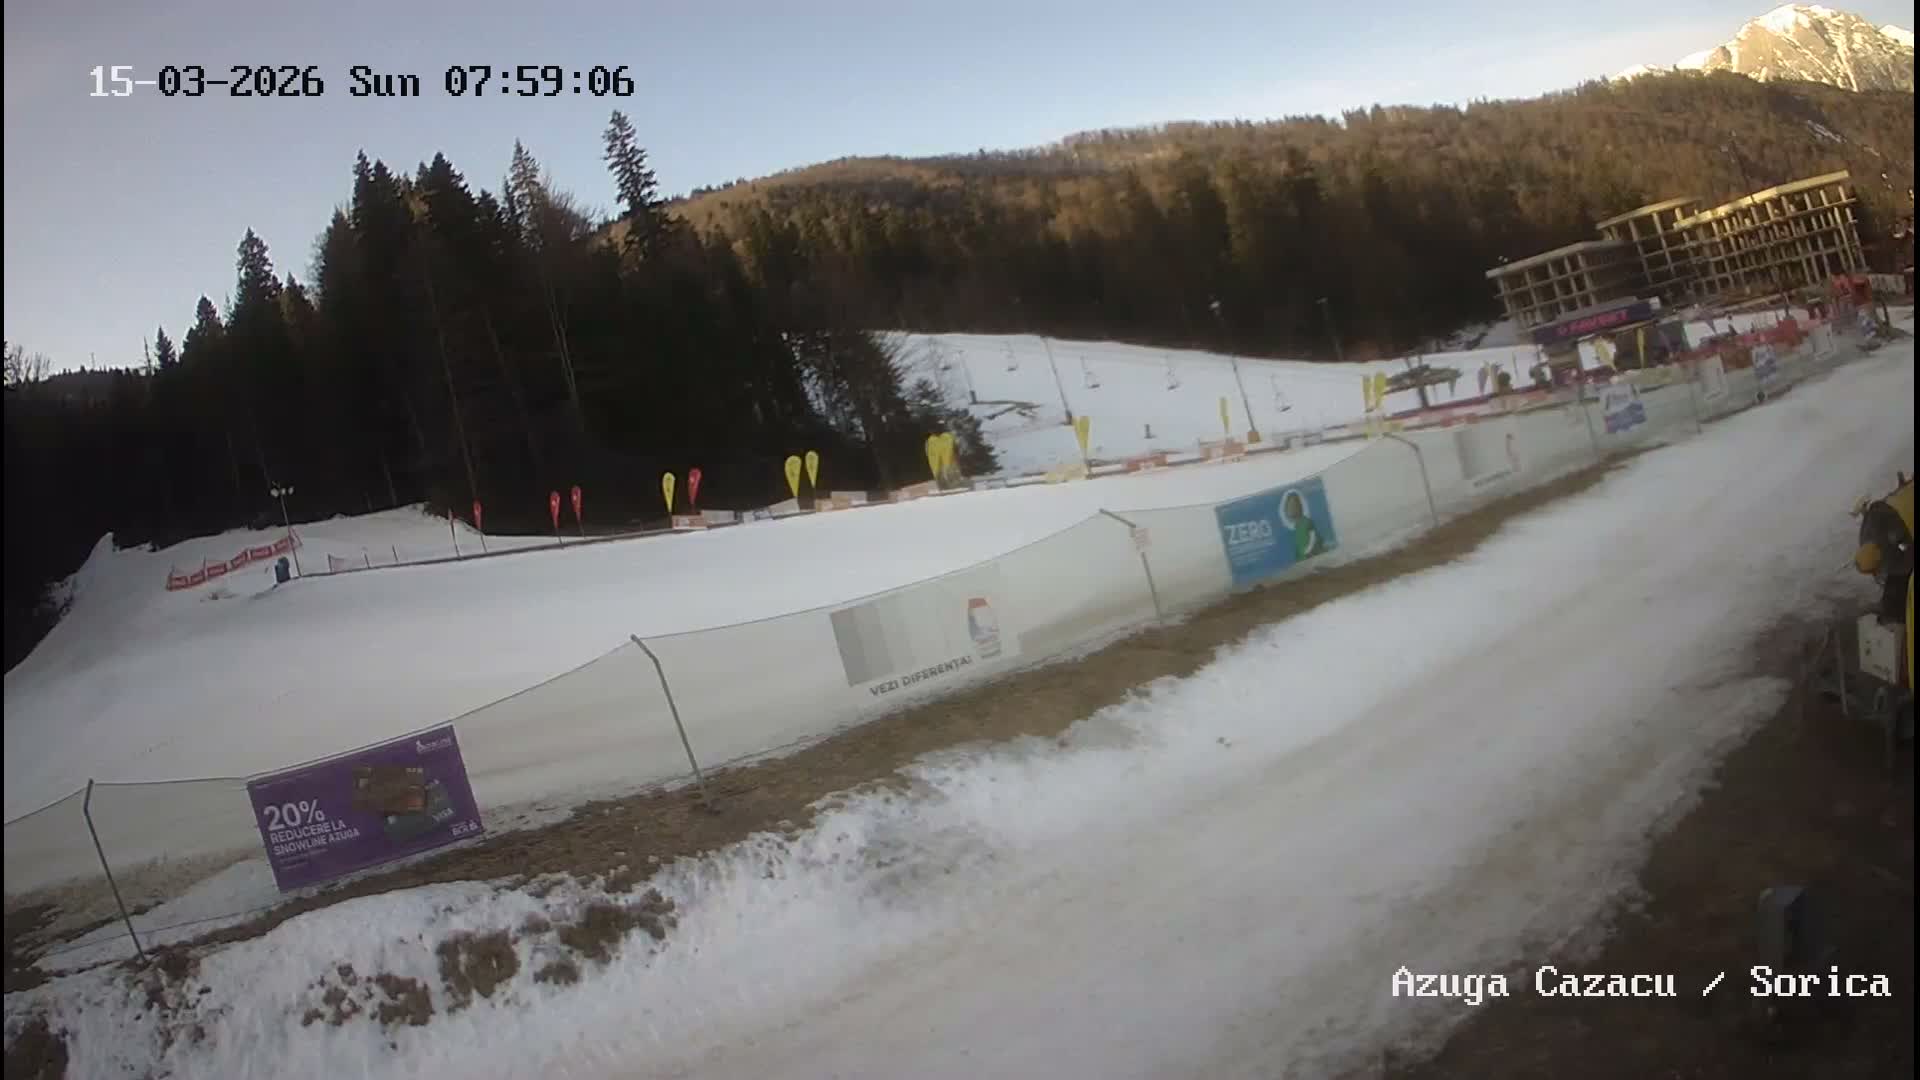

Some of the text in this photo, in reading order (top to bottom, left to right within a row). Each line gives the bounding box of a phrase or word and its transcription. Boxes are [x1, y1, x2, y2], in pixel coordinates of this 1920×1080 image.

[1223, 519, 1273, 544] ZERO
[869, 680, 899, 697] VEZI
[263, 799, 325, 831] 20%
[270, 819, 347, 845] REDUCERE LA
[273, 834, 327, 855] SNOWLINE
[328, 827, 360, 843] AZUGA
